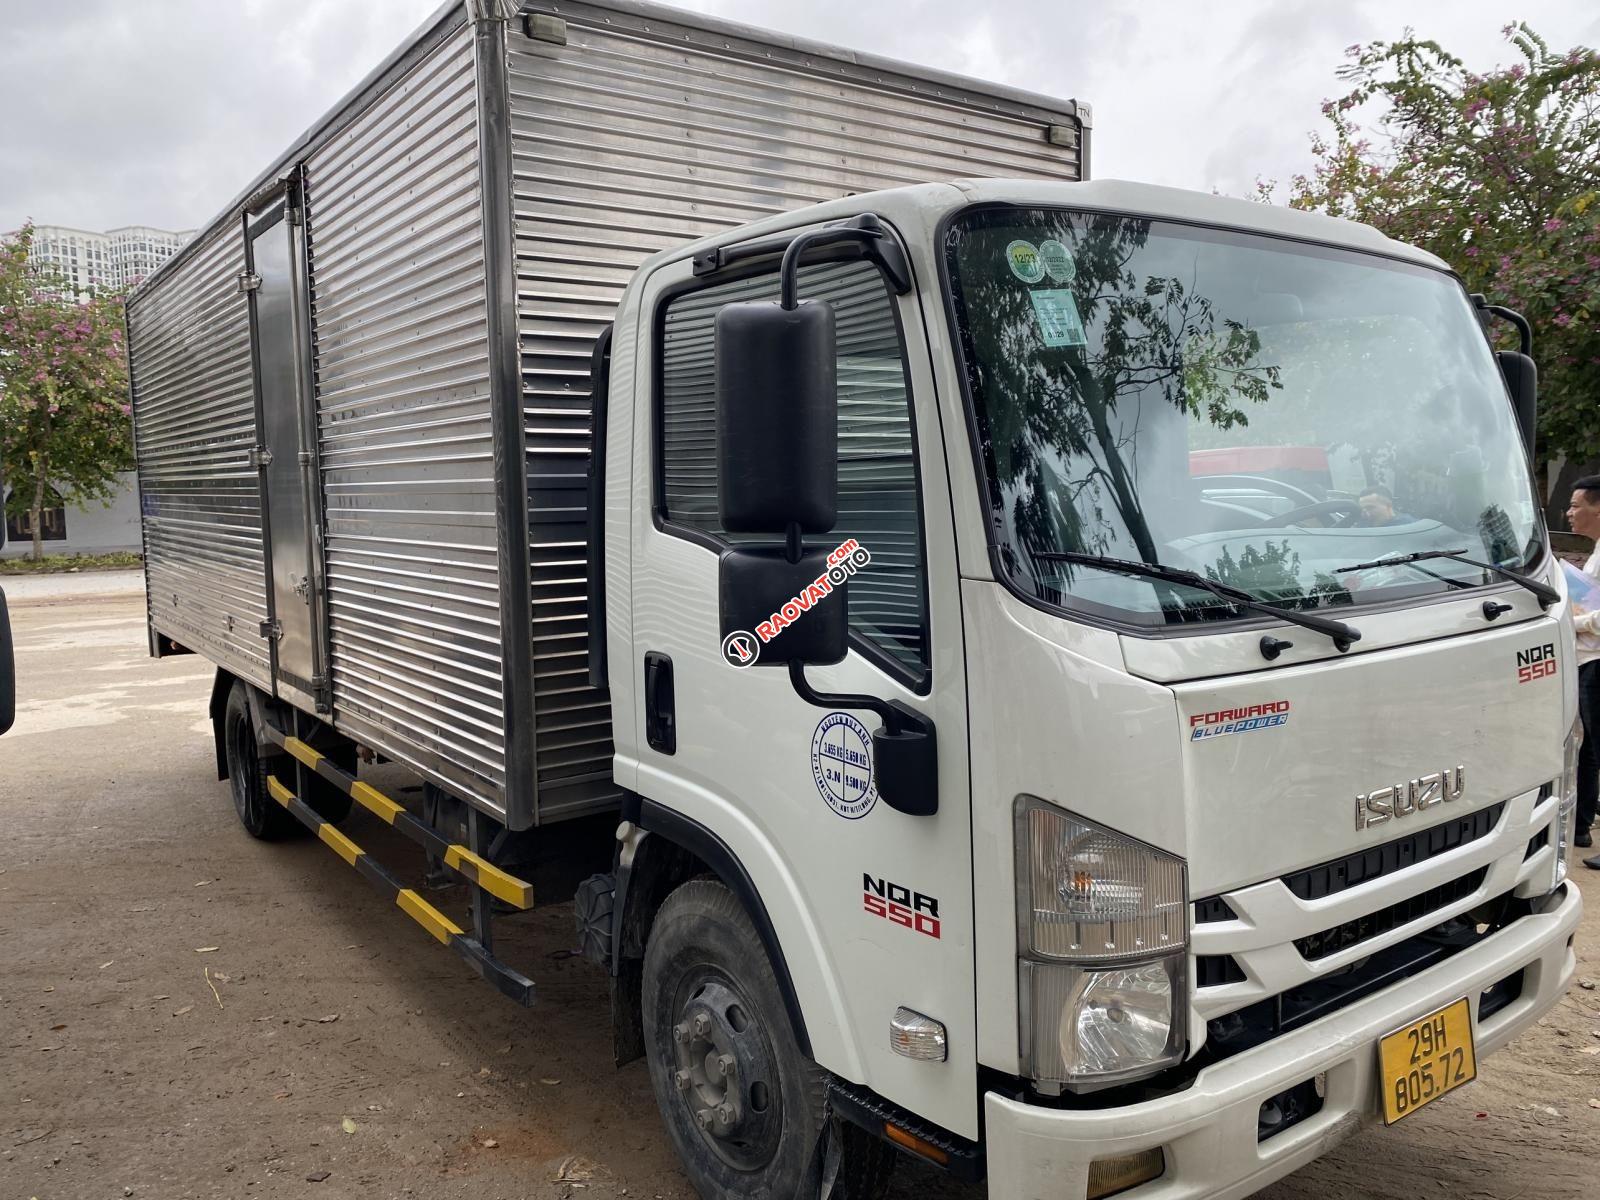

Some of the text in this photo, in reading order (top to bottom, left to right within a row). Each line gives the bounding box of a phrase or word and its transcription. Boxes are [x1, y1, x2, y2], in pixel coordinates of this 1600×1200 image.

[1078, 107, 1090, 118] TN
[1516, 643, 1555, 667] NQR
[1518, 659, 1556, 684] 550
[1190, 700, 1289, 727] FORWARD
[1192, 714, 1288, 740] BLUEPOWER
[859, 752, 867, 766] KG
[859, 777, 867, 792] KG
[1355, 764, 1465, 832] ISUZU
[863, 872, 940, 918] NQR
[863, 892, 941, 940] 550
[1408, 1014, 1447, 1065] 29H
[1395, 1047, 1465, 1113] 805.72
